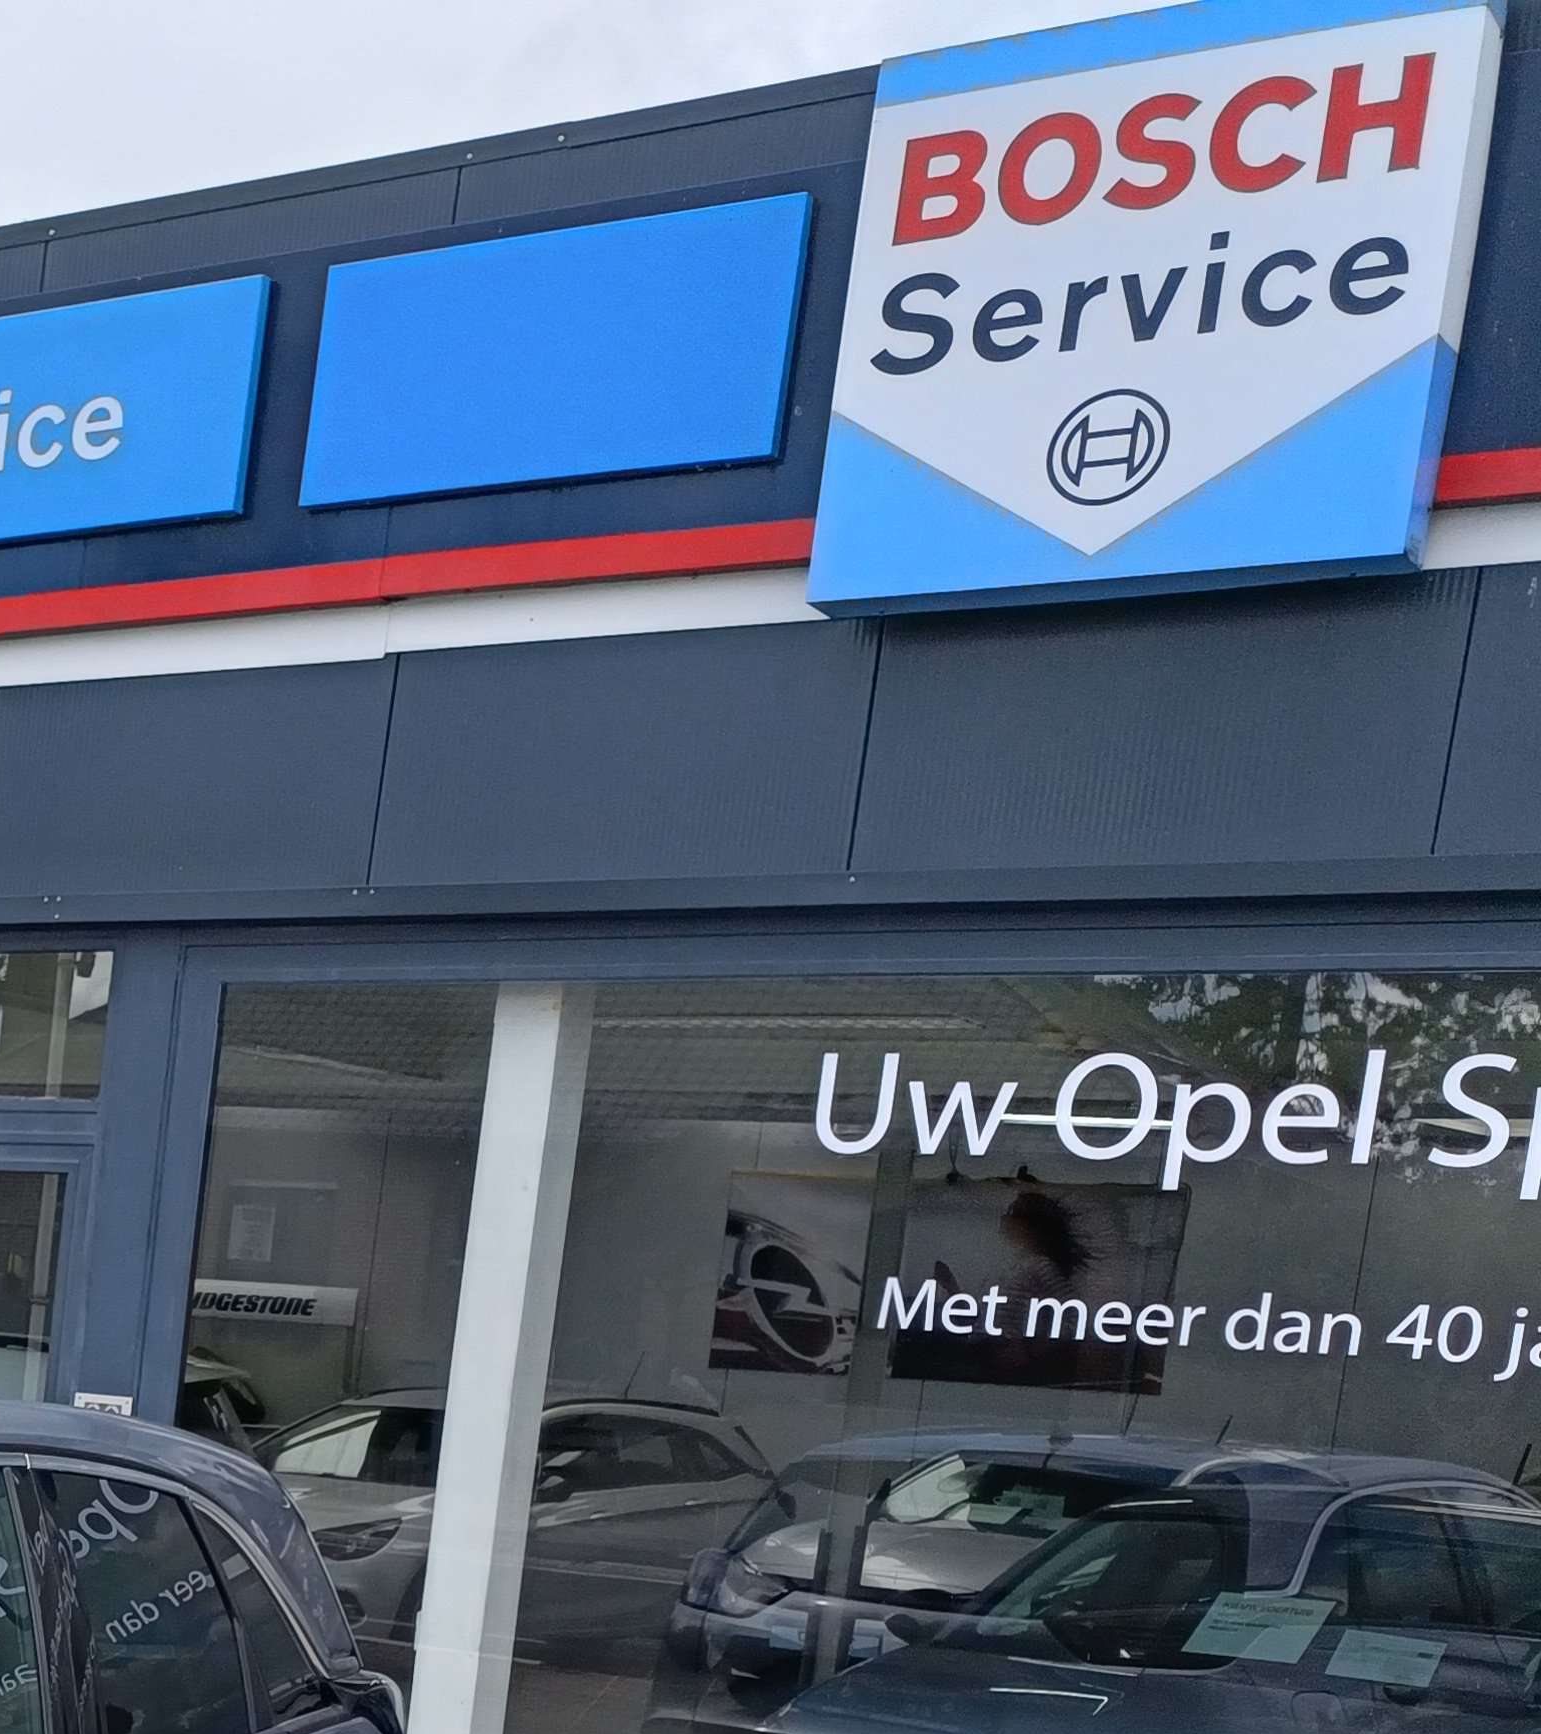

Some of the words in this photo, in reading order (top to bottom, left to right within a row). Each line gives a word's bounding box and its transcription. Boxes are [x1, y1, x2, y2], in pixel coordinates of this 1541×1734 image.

[892, 52, 1436, 246] BOSCH
[869, 231, 1409, 375] Service
[815, 1052, 1019, 1156] Uw
[1055, 1049, 1387, 1191] Opel
[1427, 1053, 1541, 1200] S
[875, 1275, 1007, 1336] Met
[1024, 1296, 1207, 1347] meer
[1224, 1292, 1363, 1357] dan
[1386, 1304, 1483, 1364] 40
[1493, 1308, 1541, 1383] j
